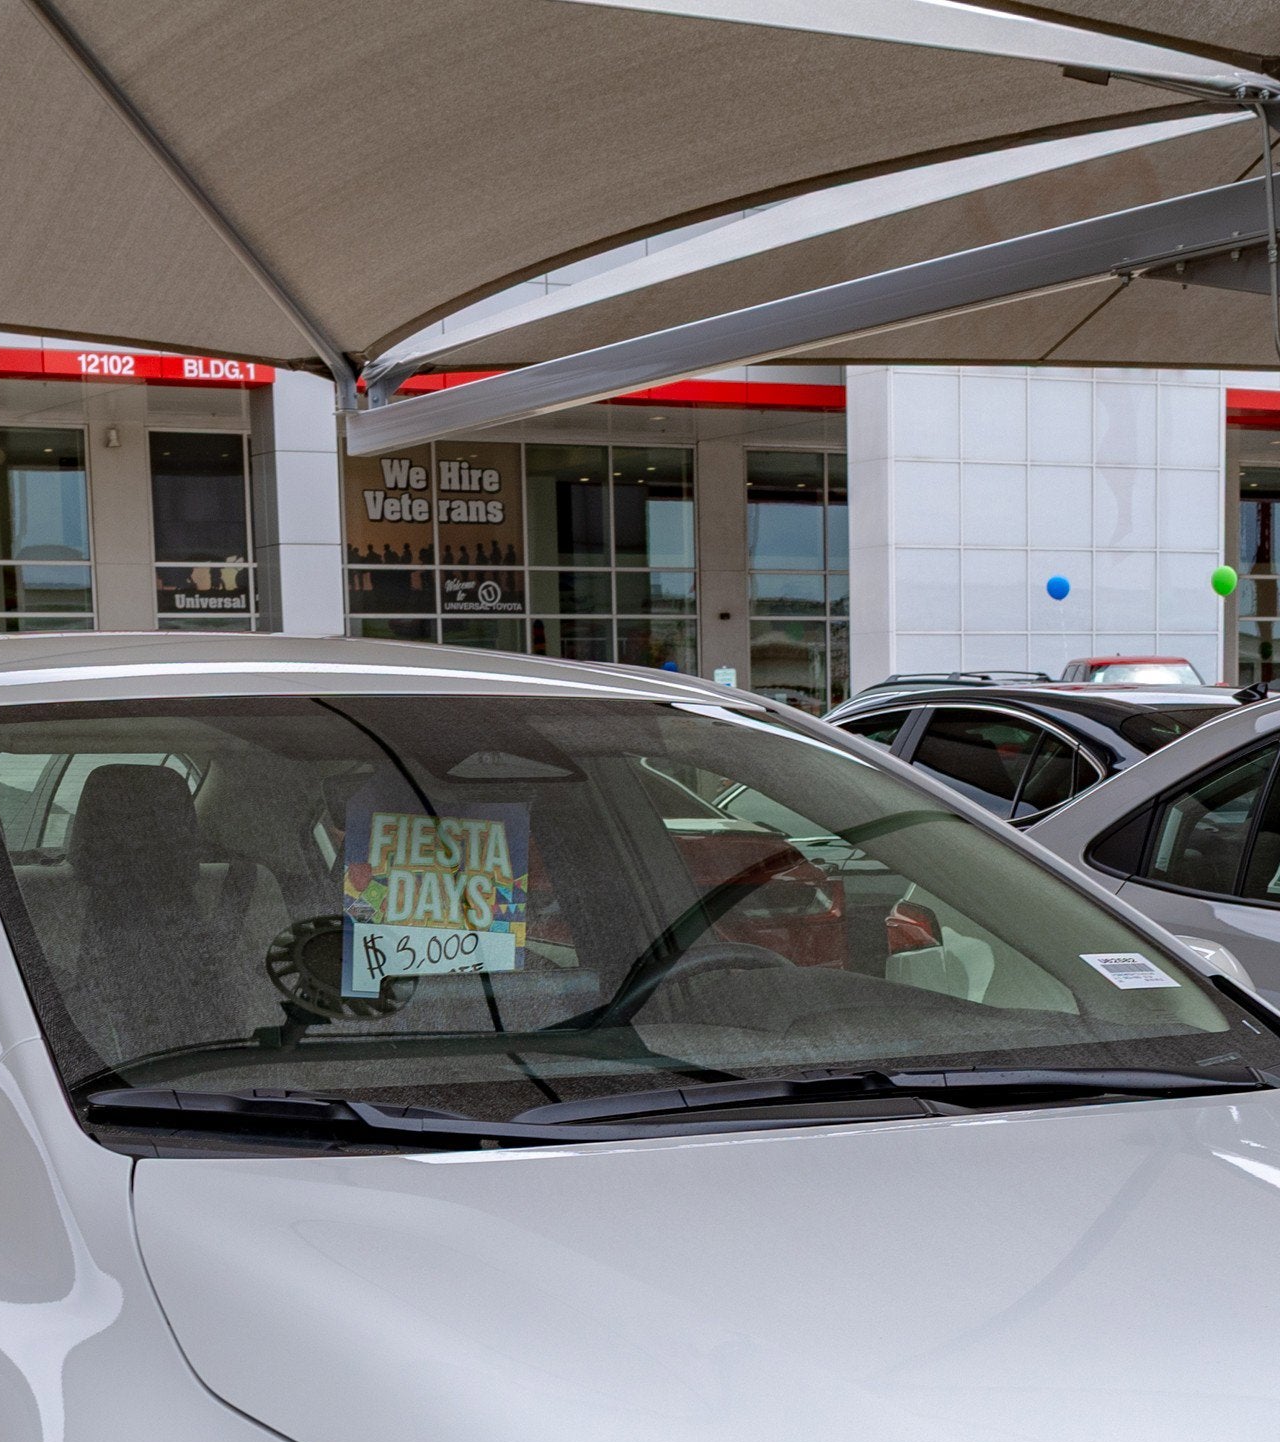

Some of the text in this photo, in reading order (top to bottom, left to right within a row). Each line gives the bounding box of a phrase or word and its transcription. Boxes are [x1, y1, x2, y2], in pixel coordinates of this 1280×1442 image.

[77, 353, 135, 375] 12102
[381, 458, 501, 492] We Hire
[174, 594, 247, 609] Universal
[444, 602, 523, 610] UNIVERSAL TOYOTA
[370, 814, 513, 882] FIESTA
[384, 868, 494, 929] DAYS
